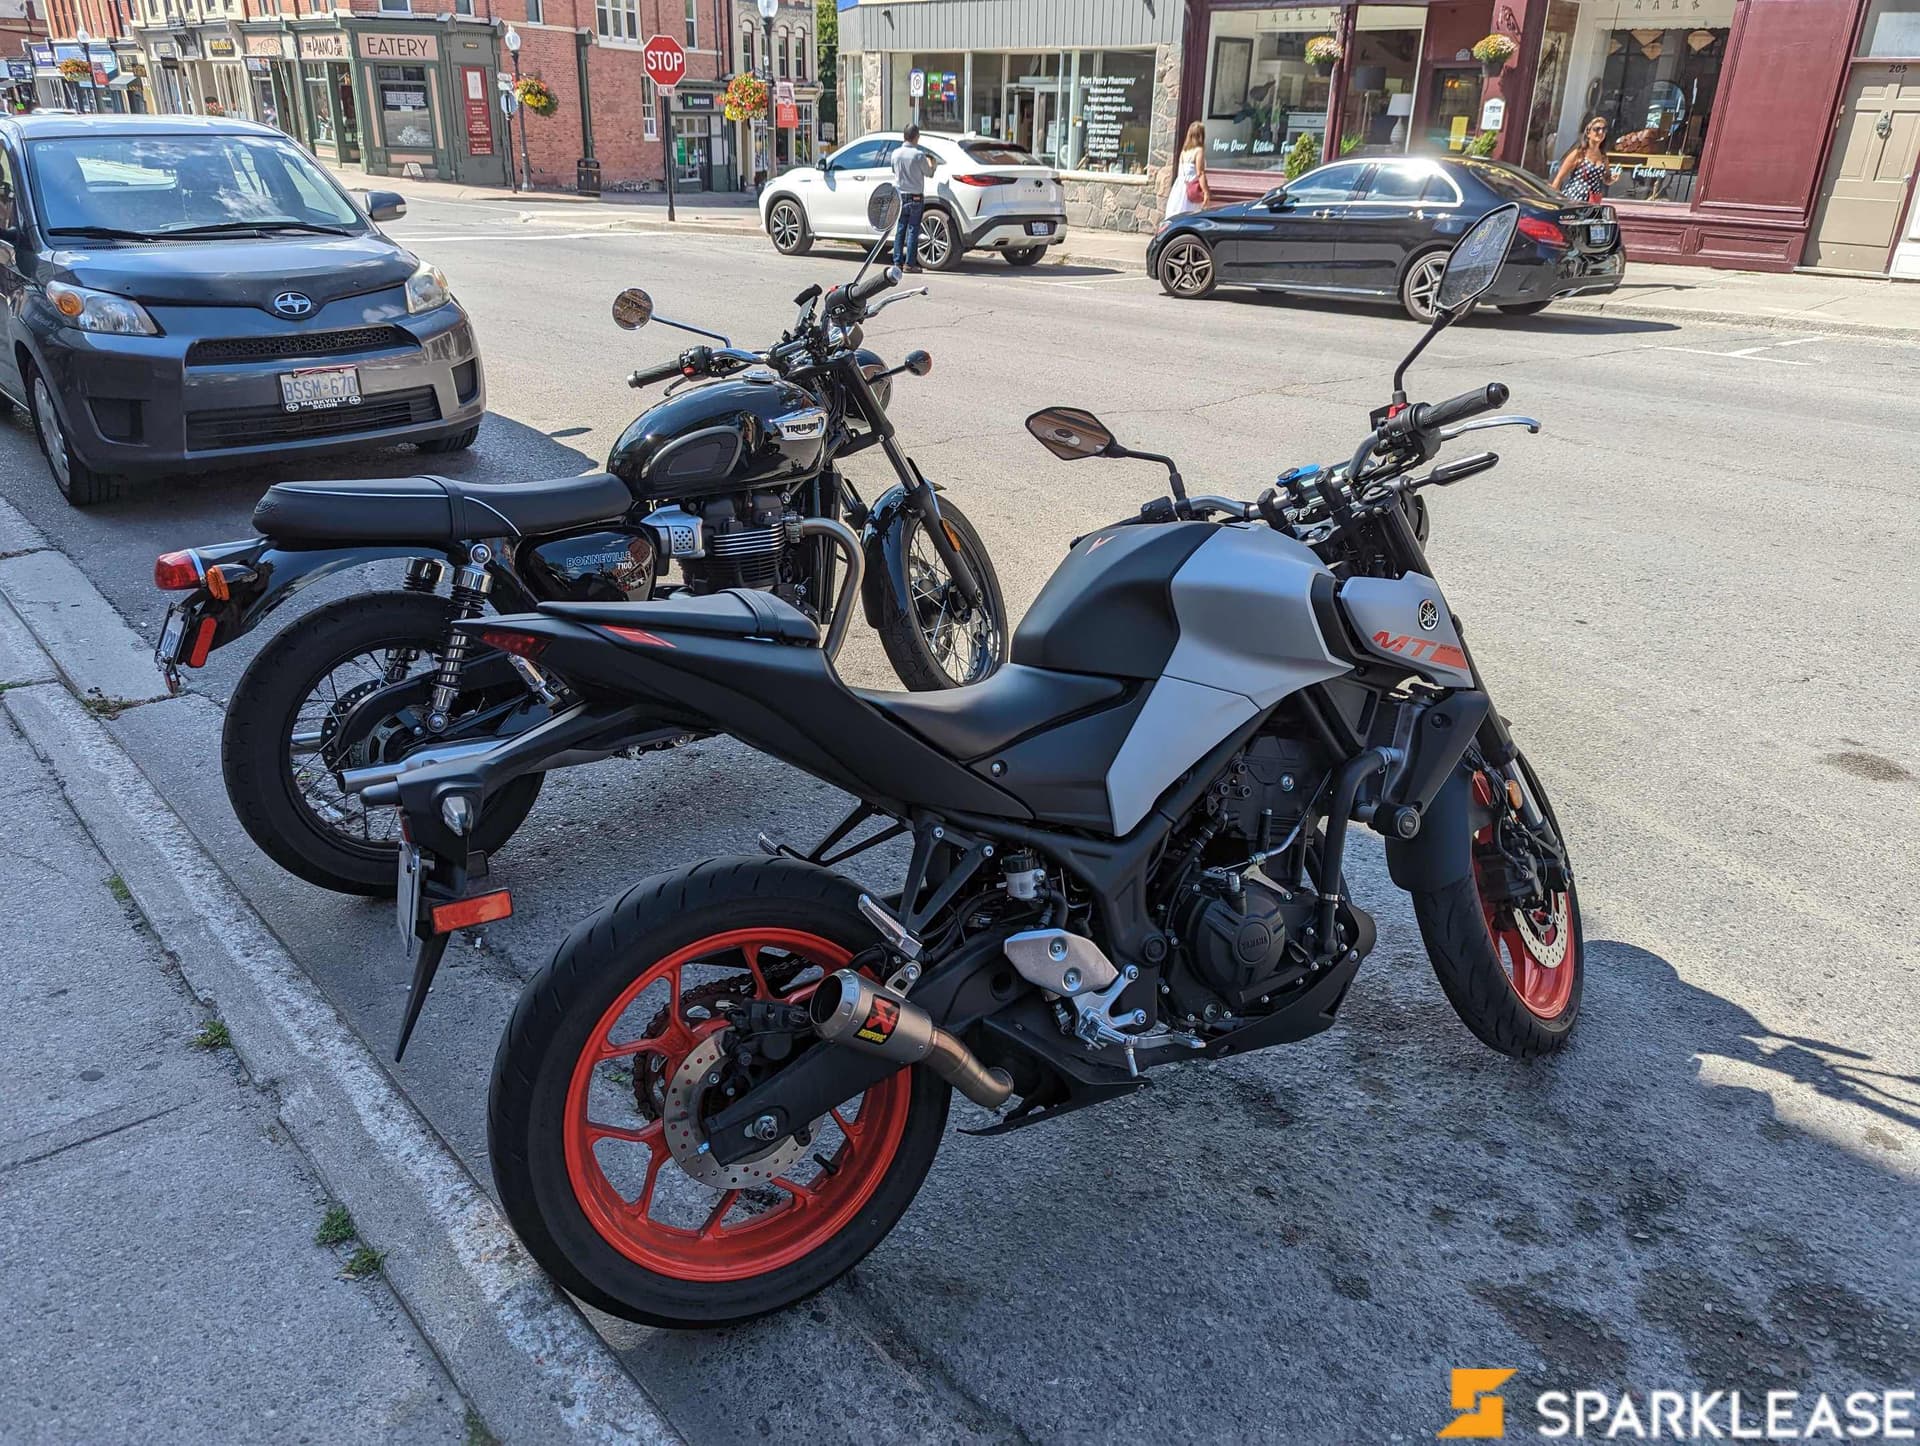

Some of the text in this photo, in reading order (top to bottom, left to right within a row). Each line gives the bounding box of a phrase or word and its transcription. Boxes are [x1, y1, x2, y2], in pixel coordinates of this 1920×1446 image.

[367, 37, 428, 57] EATERY
[646, 51, 683, 72] STOP
[1889, 64, 1907, 73] 205
[1080, 76, 1136, 86] Port Perry Pharmacy
[1632, 163, 1666, 179] Fashion
[284, 376, 356, 401] BSSM 670
[300, 397, 347, 406] MARKVILLE
[785, 422, 819, 435] TRIUMPH
[566, 552, 631, 567] BONNEVILLE
[617, 562, 632, 570] T100
[1372, 631, 1437, 657] MT
